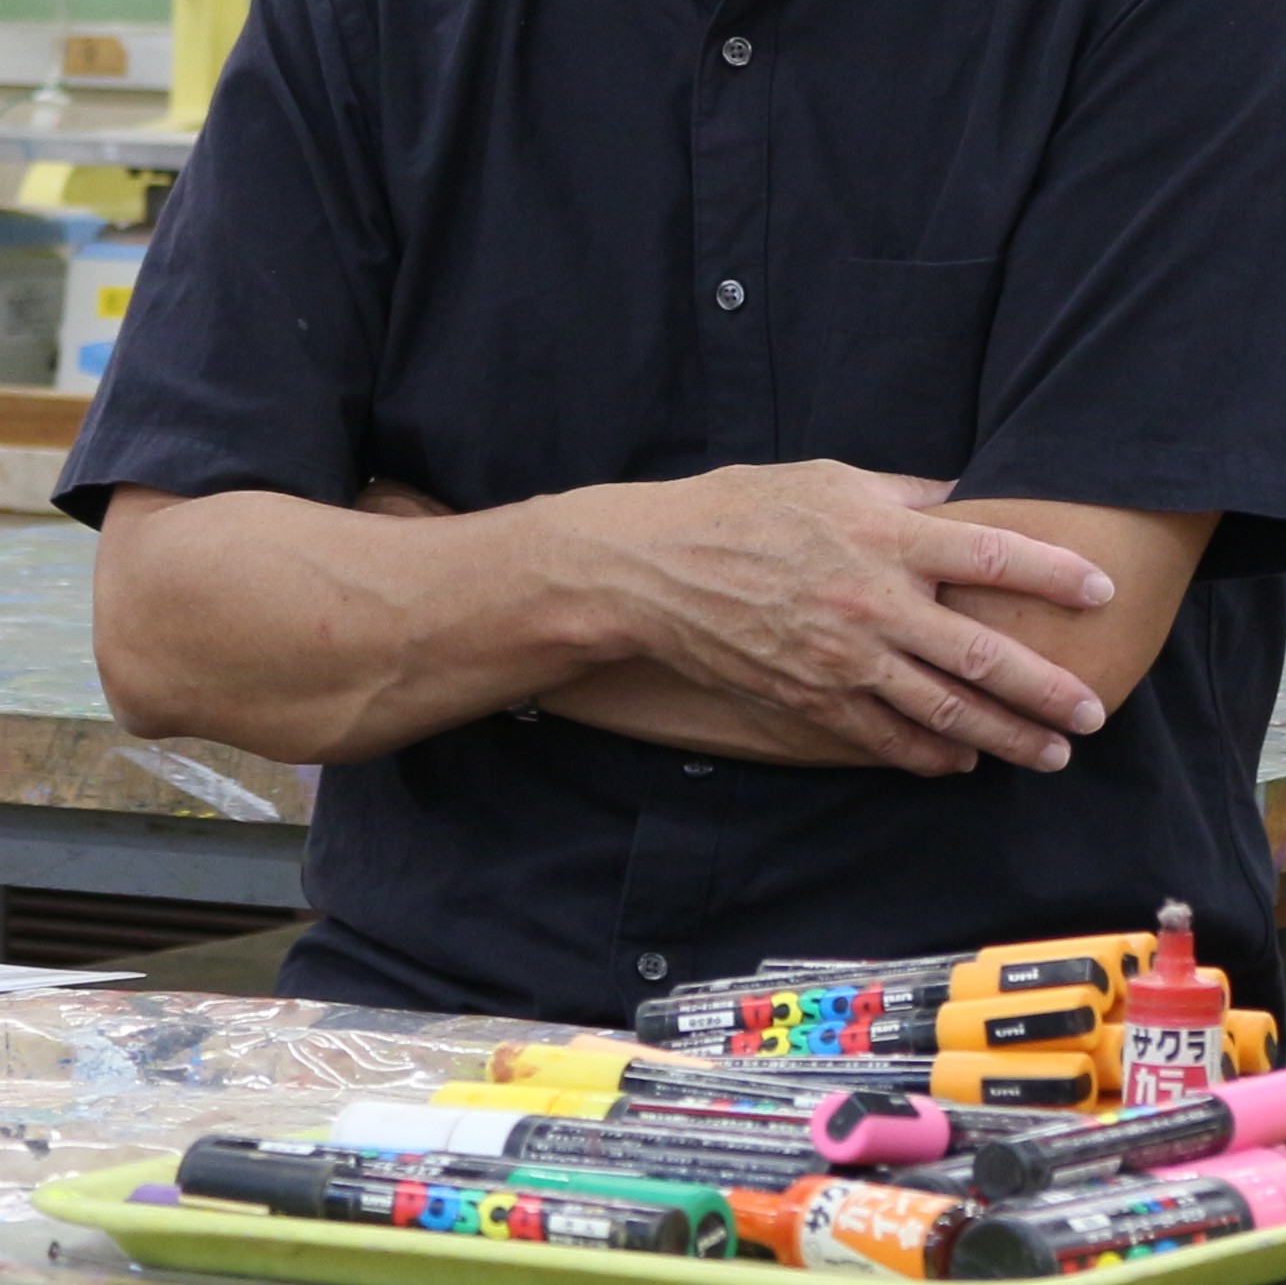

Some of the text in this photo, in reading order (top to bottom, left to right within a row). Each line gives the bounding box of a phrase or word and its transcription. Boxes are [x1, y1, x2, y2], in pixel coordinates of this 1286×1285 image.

[1007, 968, 1039, 982] uni
[740, 981, 886, 1030] POSCA
[729, 1017, 873, 1057] POSCA
[994, 1023, 1025, 1038] uni
[1132, 1028, 1206, 1062] サクラ
[393, 1179, 545, 1241] POSCA
